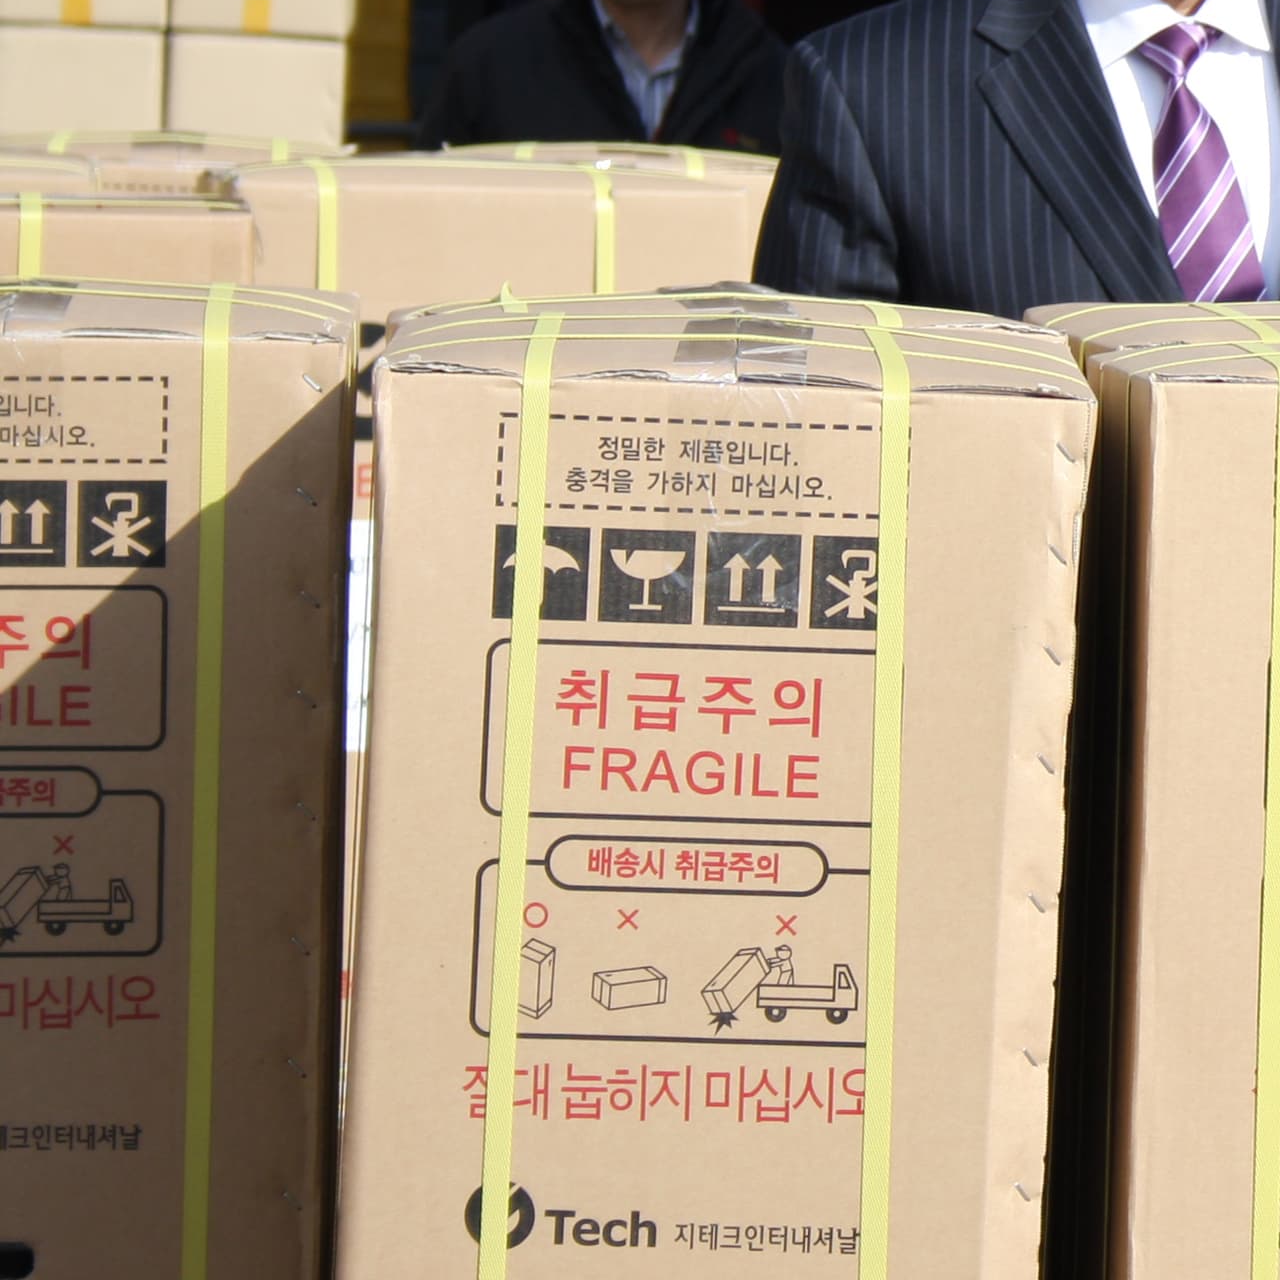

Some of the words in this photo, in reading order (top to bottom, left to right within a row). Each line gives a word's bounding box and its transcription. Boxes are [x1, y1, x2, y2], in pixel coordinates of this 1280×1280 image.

[598, 437, 665, 461] 정밀한
[679, 440, 798, 466] 제품입니다.
[566, 467, 633, 493] 충격을
[648, 471, 716, 496] 가하지
[732, 474, 831, 500] 마십시오.
[0, 682, 93, 727] ILE
[556, 670, 822, 737] 취급주의
[563, 746, 820, 798] FRAGILE
[588, 848, 665, 878] 배송시
[677, 850, 779, 882] 취급주의
[562, 1065, 692, 1120] 눕히지
[545, 1210, 656, 1247] Tech
[675, 1223, 861, 1256] 지테크인터내셔날
